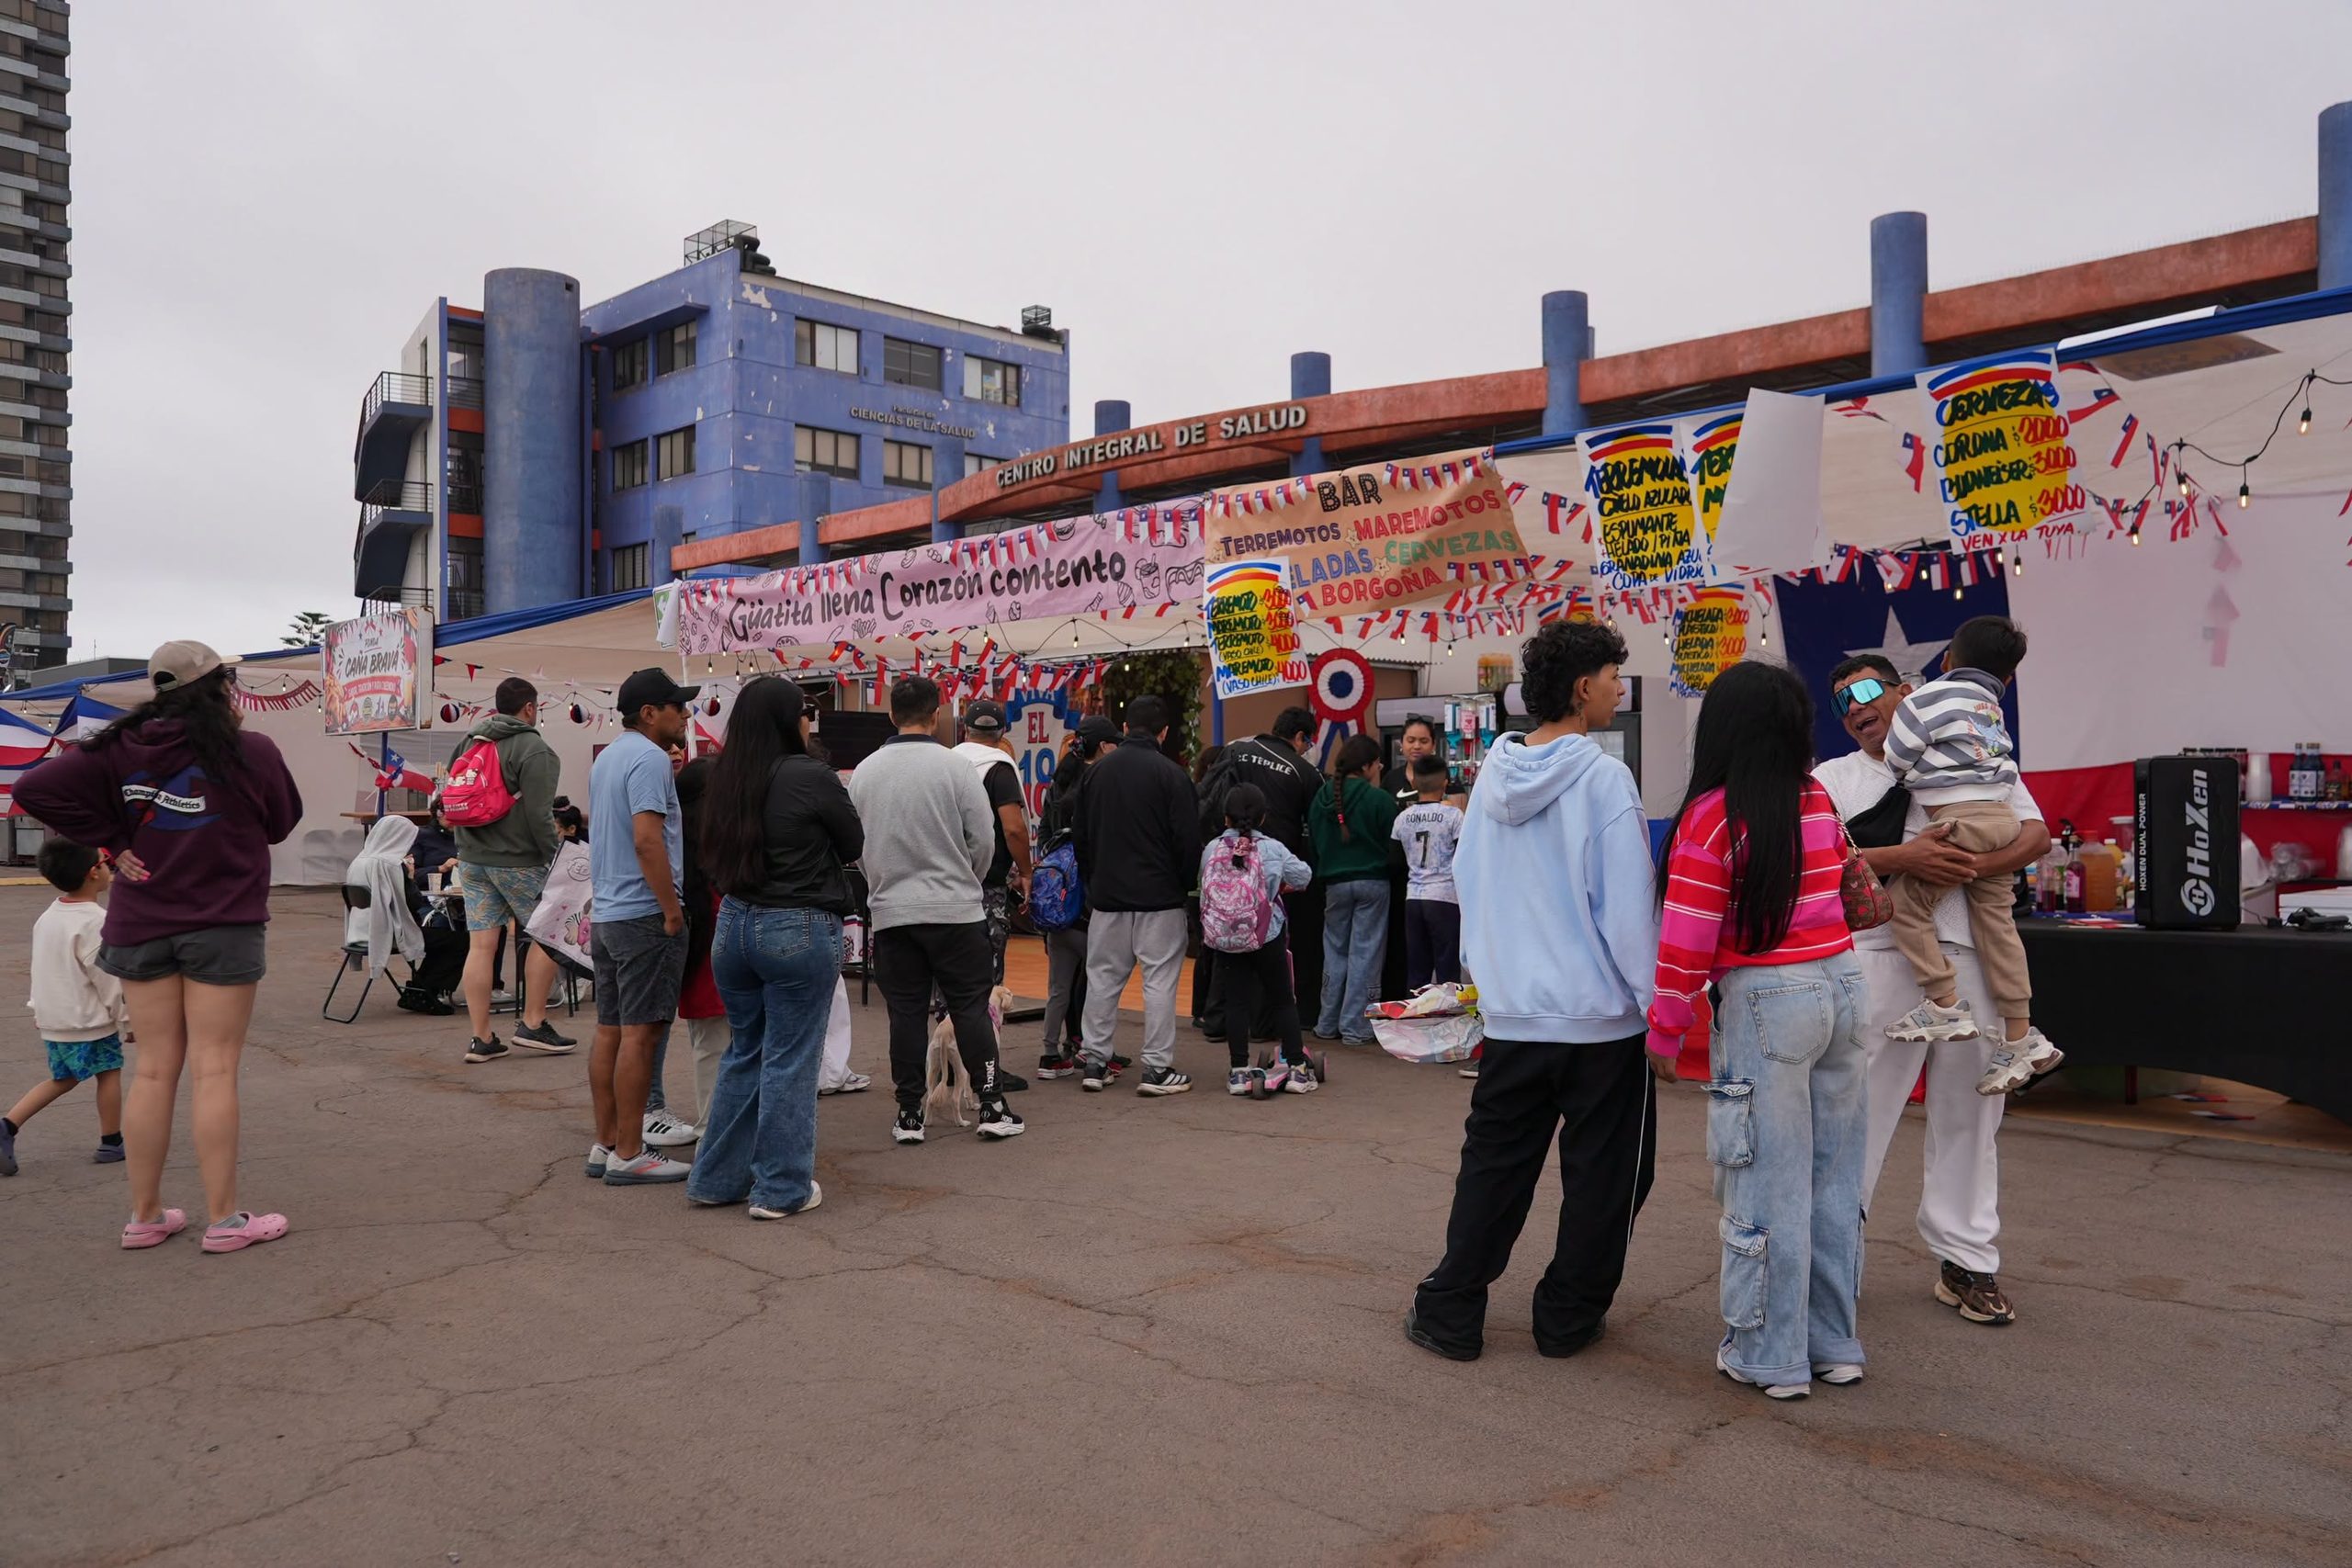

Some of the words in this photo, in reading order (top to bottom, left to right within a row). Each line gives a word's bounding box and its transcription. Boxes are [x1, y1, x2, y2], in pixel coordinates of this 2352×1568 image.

[851, 406, 903, 426] CIENCIAS
[906, 417, 920, 428] DE
[922, 421, 937, 432] LA
[939, 422, 976, 439] SALUD
[996, 455, 1055, 488] CENTRO
[1065, 433, 1163, 469] INTEGRAL
[1174, 423, 1206, 447] DE
[1219, 405, 1306, 440] SALUD
[1317, 473, 1383, 513] BAR
[1939, 459, 2033, 502] BUDWEISER
[1219, 522, 1341, 557] TERREMOTOS
[1353, 489, 1501, 542] MAREMOTOS
[1951, 499, 2021, 536] STELLA
[1385, 530, 1518, 566] CERVEZAS
[1962, 533, 1994, 551] VEN
[2010, 530, 2028, 542] LA
[729, 598, 813, 643] Güatita
[820, 588, 874, 626] llena
[880, 569, 982, 622] Corazón
[990, 549, 1126, 597] contento
[1321, 567, 1442, 606] BORGOÑA
[1612, 571, 1648, 591] COPA
[345, 649, 368, 678] CAÑA
[369, 649, 400, 674] BRAVA
[1216, 658, 1274, 682] MAREMOTO
[1222, 679, 1250, 695] (VASO
[1027, 711, 1049, 744] EL
[1250, 754, 1293, 775] TEPLICE
[161, 795, 200, 809] Athletics
[1406, 812, 1444, 823] RONALDO
[2138, 793, 2147, 829] POWER
[1415, 830, 1430, 869] 7
[2138, 831, 2147, 856] DUAL
[2138, 857, 2148, 892] HOXEN
